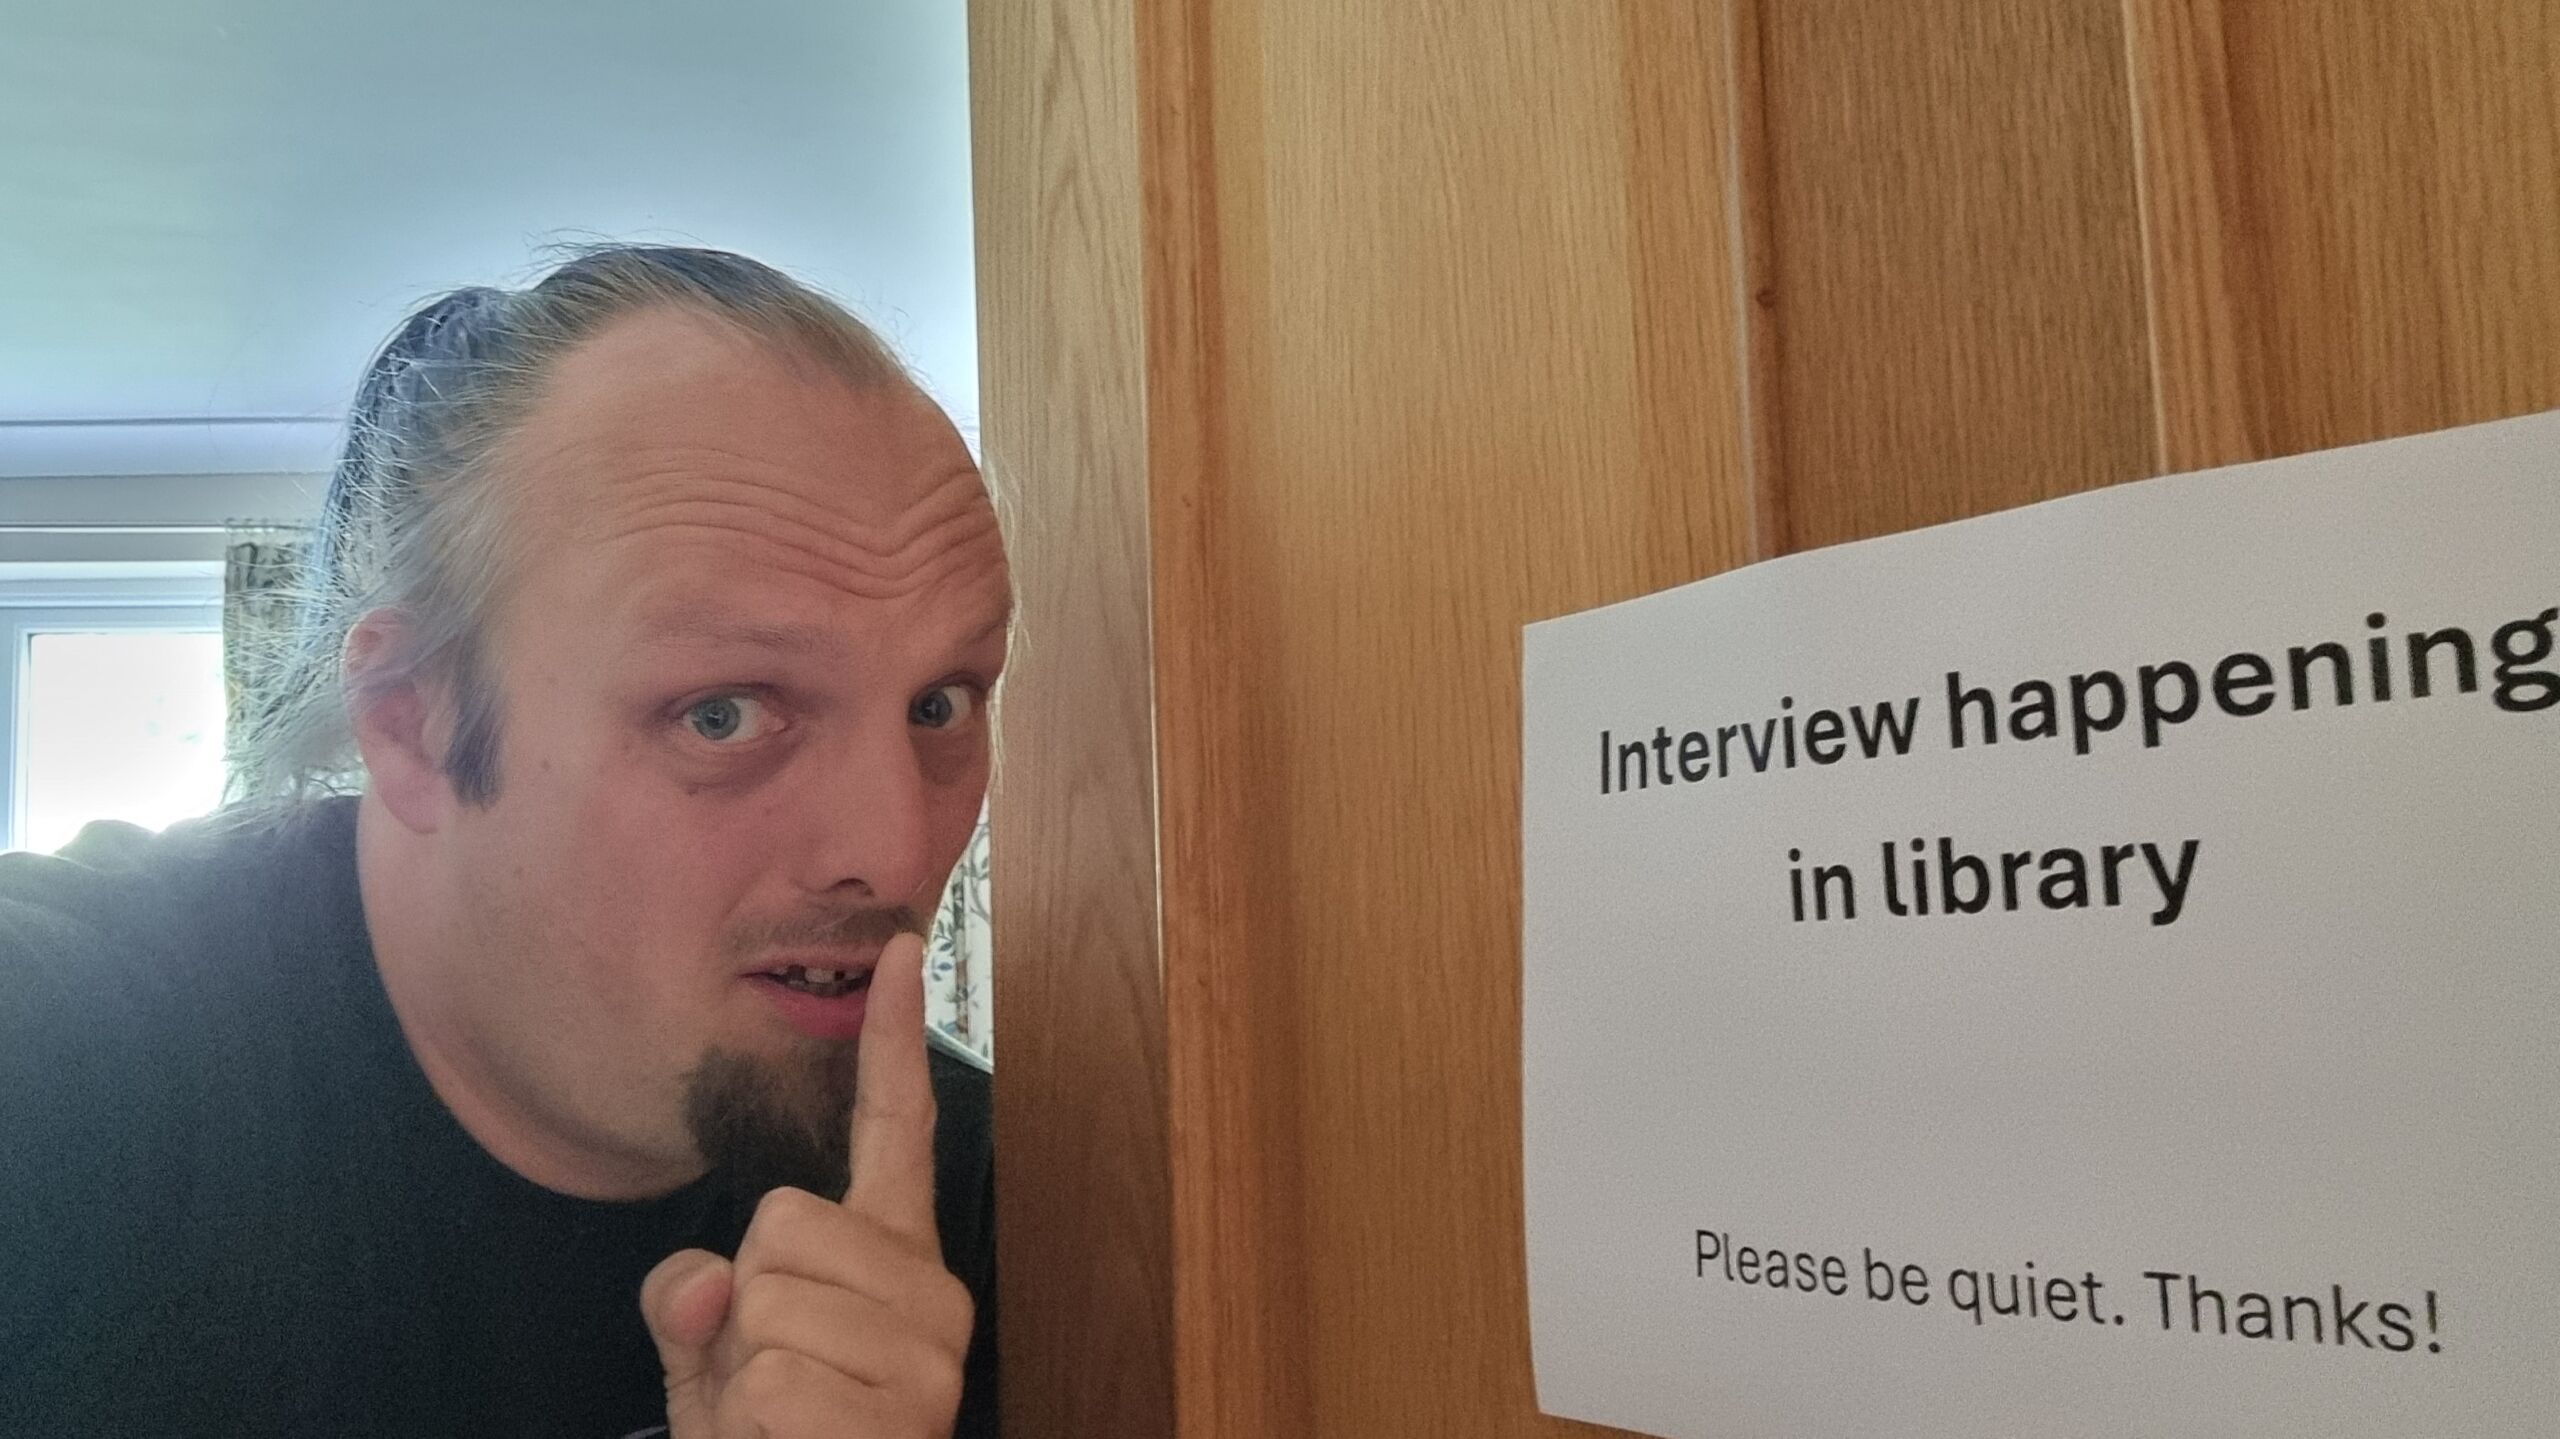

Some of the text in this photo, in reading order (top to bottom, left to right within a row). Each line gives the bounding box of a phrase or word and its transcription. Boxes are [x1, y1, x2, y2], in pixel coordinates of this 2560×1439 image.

[1600, 606, 2560, 796] Interview happening
[1787, 835, 2201, 928] in library
[1695, 1228, 2442, 1355] Please be quiet. Thanks!
